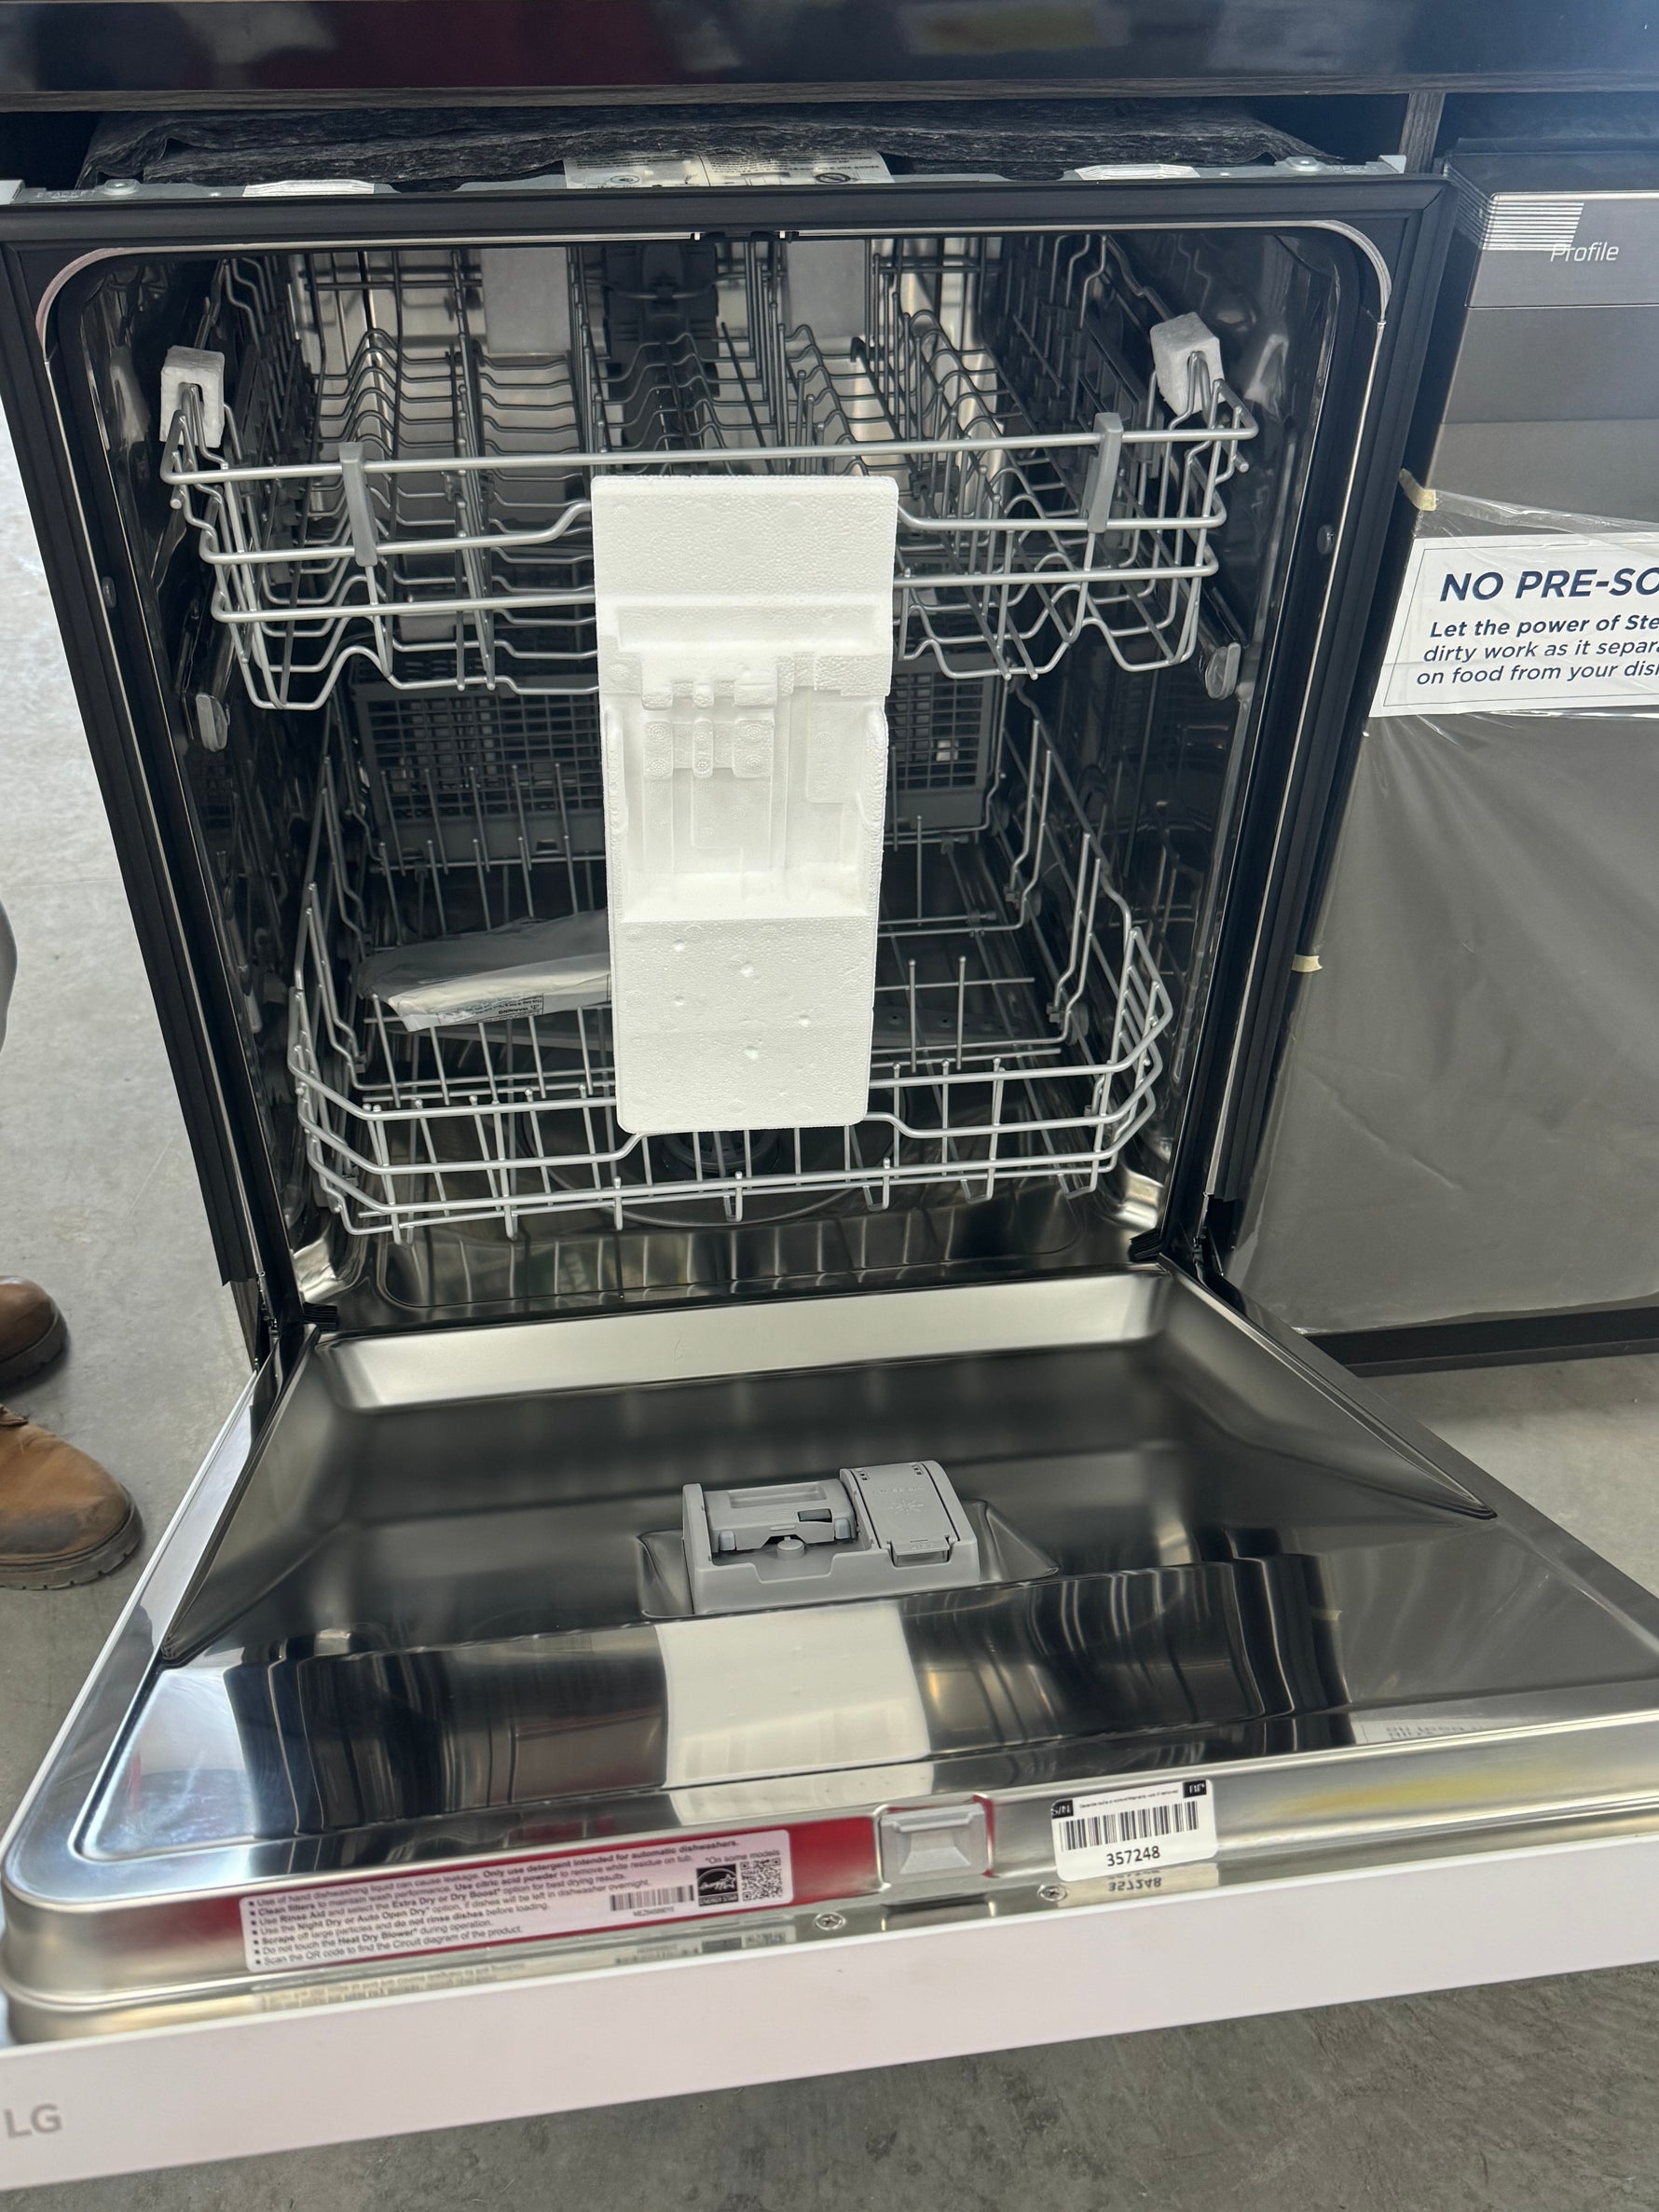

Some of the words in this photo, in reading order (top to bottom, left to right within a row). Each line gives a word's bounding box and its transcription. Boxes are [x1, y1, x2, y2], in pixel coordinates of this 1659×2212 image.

[1550, 242, 1619, 262] Profile
[1440, 571, 1504, 602] NO
[1515, 567, 1659, 599] PRE-SO
[1430, 622, 1468, 638] Let
[1474, 619, 1510, 636] the
[1515, 618, 1590, 638] power
[1596, 614, 1622, 632] of
[1625, 614, 1659, 630] Ste
[1423, 645, 1476, 663] dirty
[1484, 641, 1539, 660] work
[1543, 643, 1568, 656] as
[1575, 639, 1591, 655] it
[1416, 672, 1444, 685] on
[1451, 666, 1503, 684] food
[1509, 665, 1561, 681] from
[1567, 663, 1618, 682] your
[749, 1848, 780, 1858] models
[1106, 1846, 1161, 1867] 357248
[288, 1893, 310, 1902] hand
[312, 1887, 368, 1900] dishwashing
[370, 1883, 393, 1892] liquid
[483, 1869, 503, 1878] Only
[527, 1861, 570, 1873] detergent
[572, 1855, 613, 1865] intended
[631, 1847, 676, 1858] automatic
[679, 1839, 738, 1852] dishwashers.
[280, 1913, 307, 1921] Rinse
[391, 1899, 417, 1907] Extra
[419, 1897, 435, 1905] Dry
[450, 1893, 466, 1902] Dry
[502, 1885, 529, 1895] option
[567, 1876, 593, 1887] drying
[596, 1873, 625, 1882] results.
[287, 1903, 314, 1911] filters
[368, 1892, 391, 1901] wash
[474, 1879, 498, 1888] citric
[523, 1872, 557, 1883] powder
[570, 1867, 602, 1875] remove
[605, 1862, 627, 1871] white
[630, 1859, 662, 1868] residue
[297, 1921, 322, 1930] Night
[325, 1918, 342, 1927] Dry
[381, 1910, 406, 1919] Open
[472, 1899, 500, 1907] dishes
[557, 1885, 606, 1896] dishwasher
[261, 1934, 295, 1944] Scrape
[311, 1930, 333, 1938] large
[426, 1915, 449, 1923] rinse
[452, 1911, 483, 1919] dishes
[486, 1907, 513, 1916] before
[294, 1941, 319, 1949] touch
[362, 1933, 377, 1942] Dry
[419, 1925, 447, 1935] during
[305, 1951, 321, 1959] QR
[392, 1939, 420, 1947] Circuit
[423, 1934, 459, 1945] diagram
[4, 2103, 62, 2138] LG
